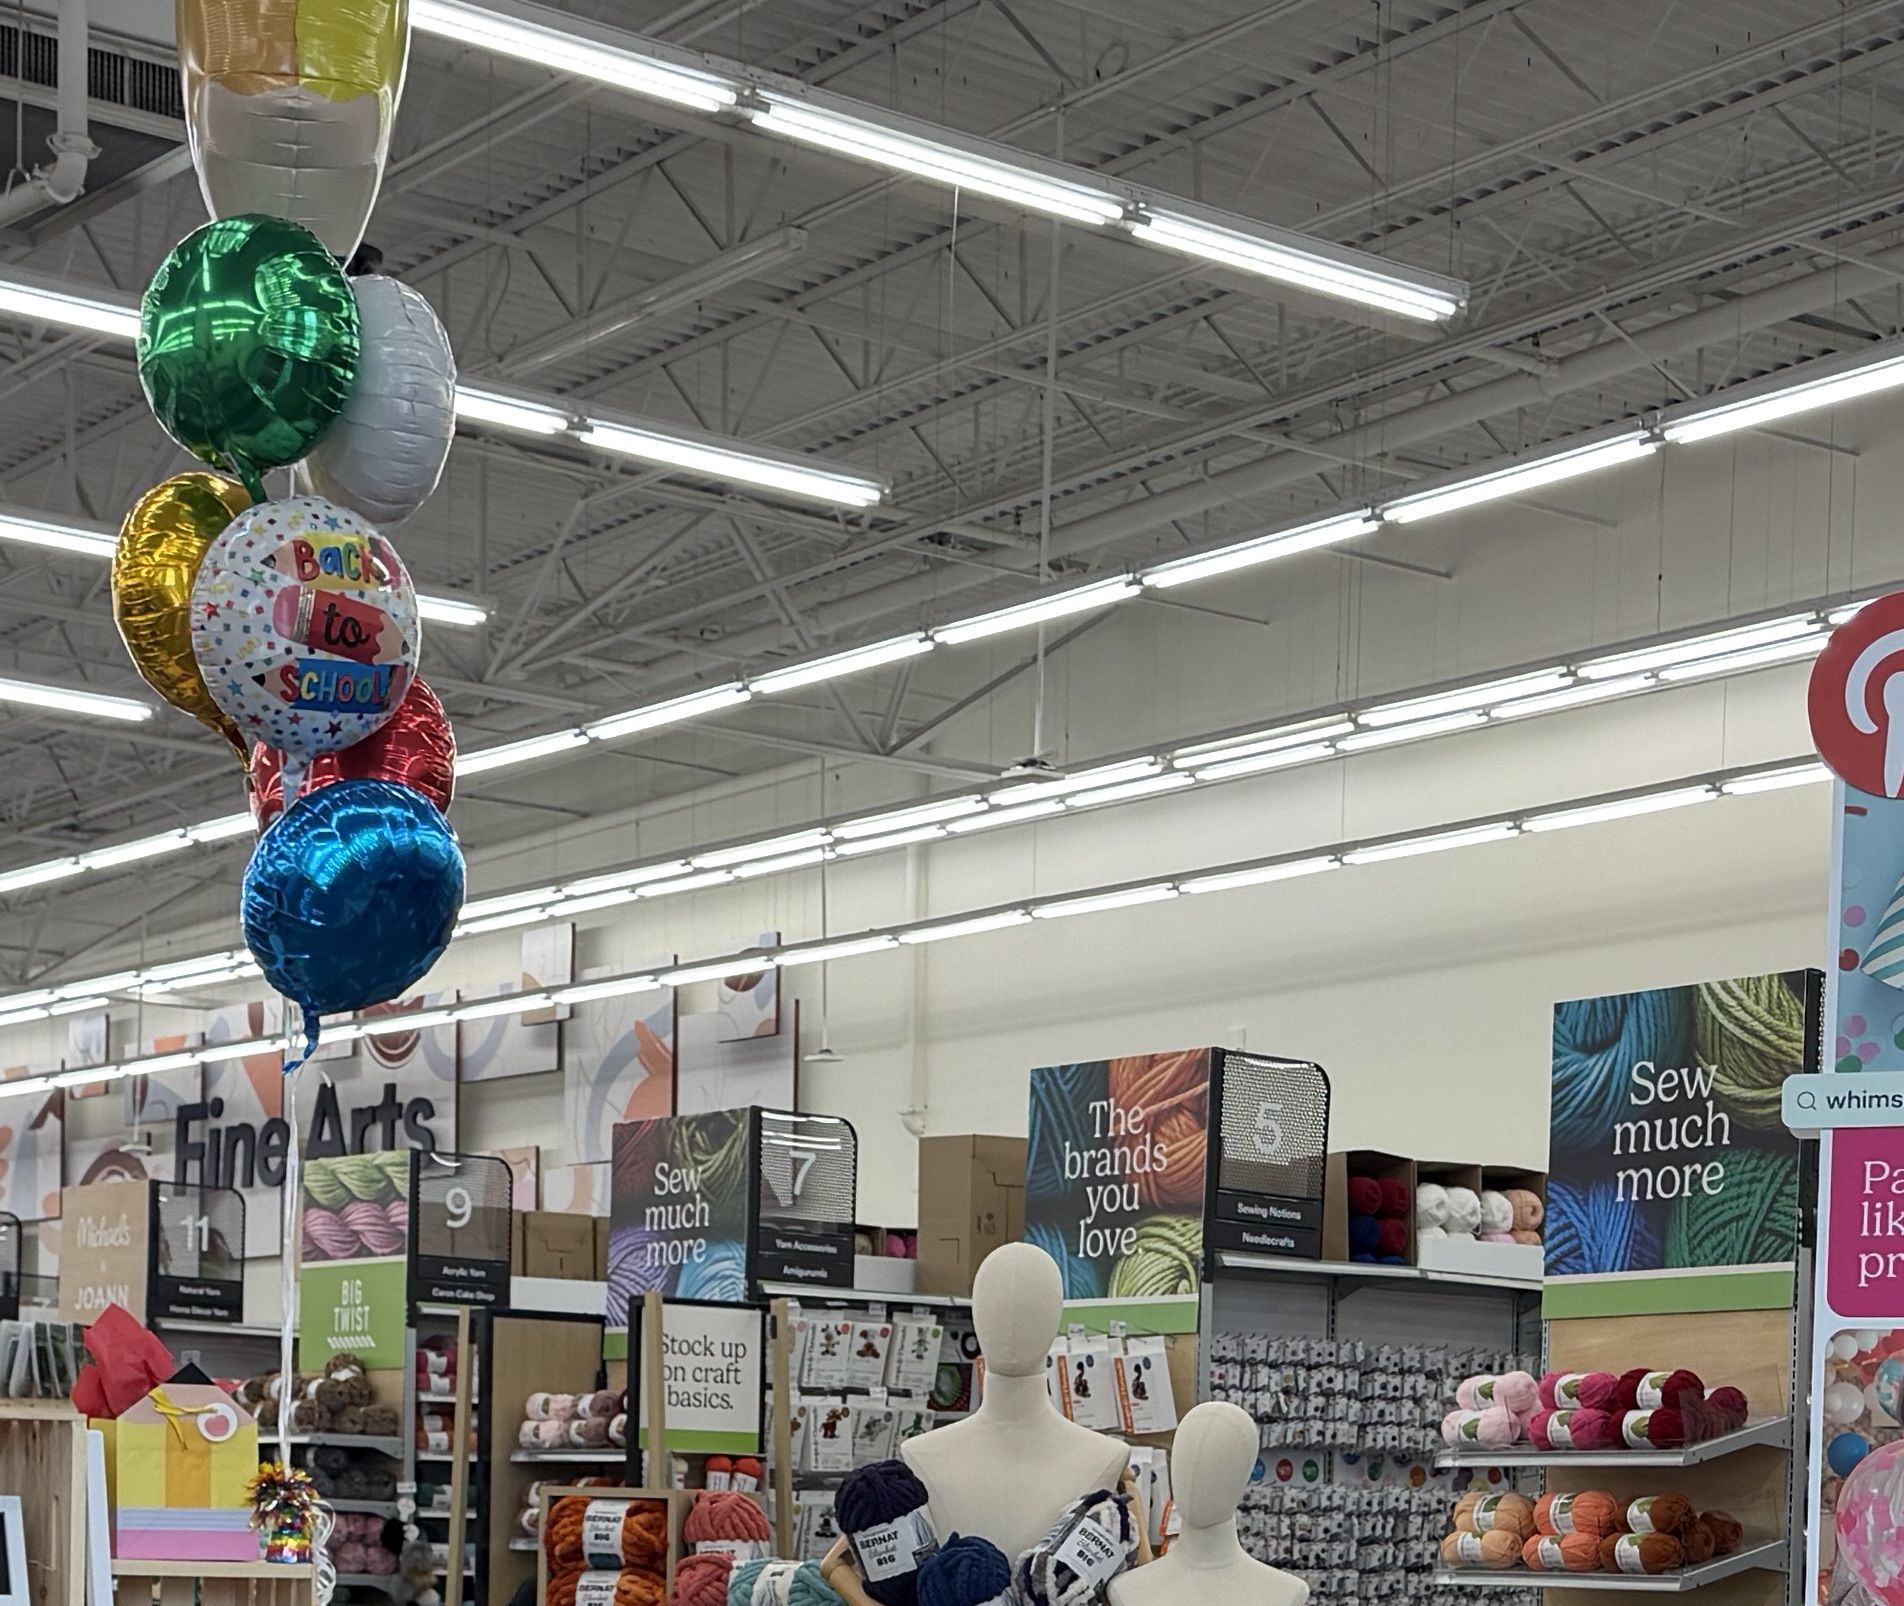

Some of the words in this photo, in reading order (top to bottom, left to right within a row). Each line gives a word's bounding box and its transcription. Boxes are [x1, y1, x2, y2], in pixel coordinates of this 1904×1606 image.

[323, 602, 371, 648] to
[1630, 1060, 1718, 1105] Sew
[1088, 1097, 1145, 1139] The
[1255, 1102, 1283, 1151] 5
[1613, 1100, 1731, 1155] much
[174, 1096, 292, 1197] Fine
[306, 1082, 437, 1161] Arts
[1064, 1133, 1168, 1180] brands
[654, 1162, 703, 1196] Sew
[789, 1150, 817, 1195] 7
[1615, 1161, 1725, 1202] more
[446, 1187, 472, 1228] 9
[645, 1196, 710, 1231] much
[1085, 1182, 1140, 1224] you
[1237, 1202, 1268, 1219] Sewing
[1269, 1205, 1302, 1221] Notions
[179, 1214, 209, 1253] 11
[1078, 1217, 1144, 1259] love.
[1242, 1231, 1295, 1249] Needlecrafts
[645, 1237, 707, 1267] more
[74, 1284, 130, 1311] JOANN
[341, 1280, 363, 1305] BIG
[334, 1306, 371, 1332] TWIST
[662, 1333, 716, 1356] Stock
[720, 1338, 747, 1360] up
[692, 1362, 742, 1385] craft
[667, 1383, 734, 1410] basics.
[859, 1530, 899, 1550] BERNAT
[1078, 1527, 1116, 1560] BERNAT
[876, 1552, 896, 1567] BIG
[1077, 1549, 1096, 1568] BIG
